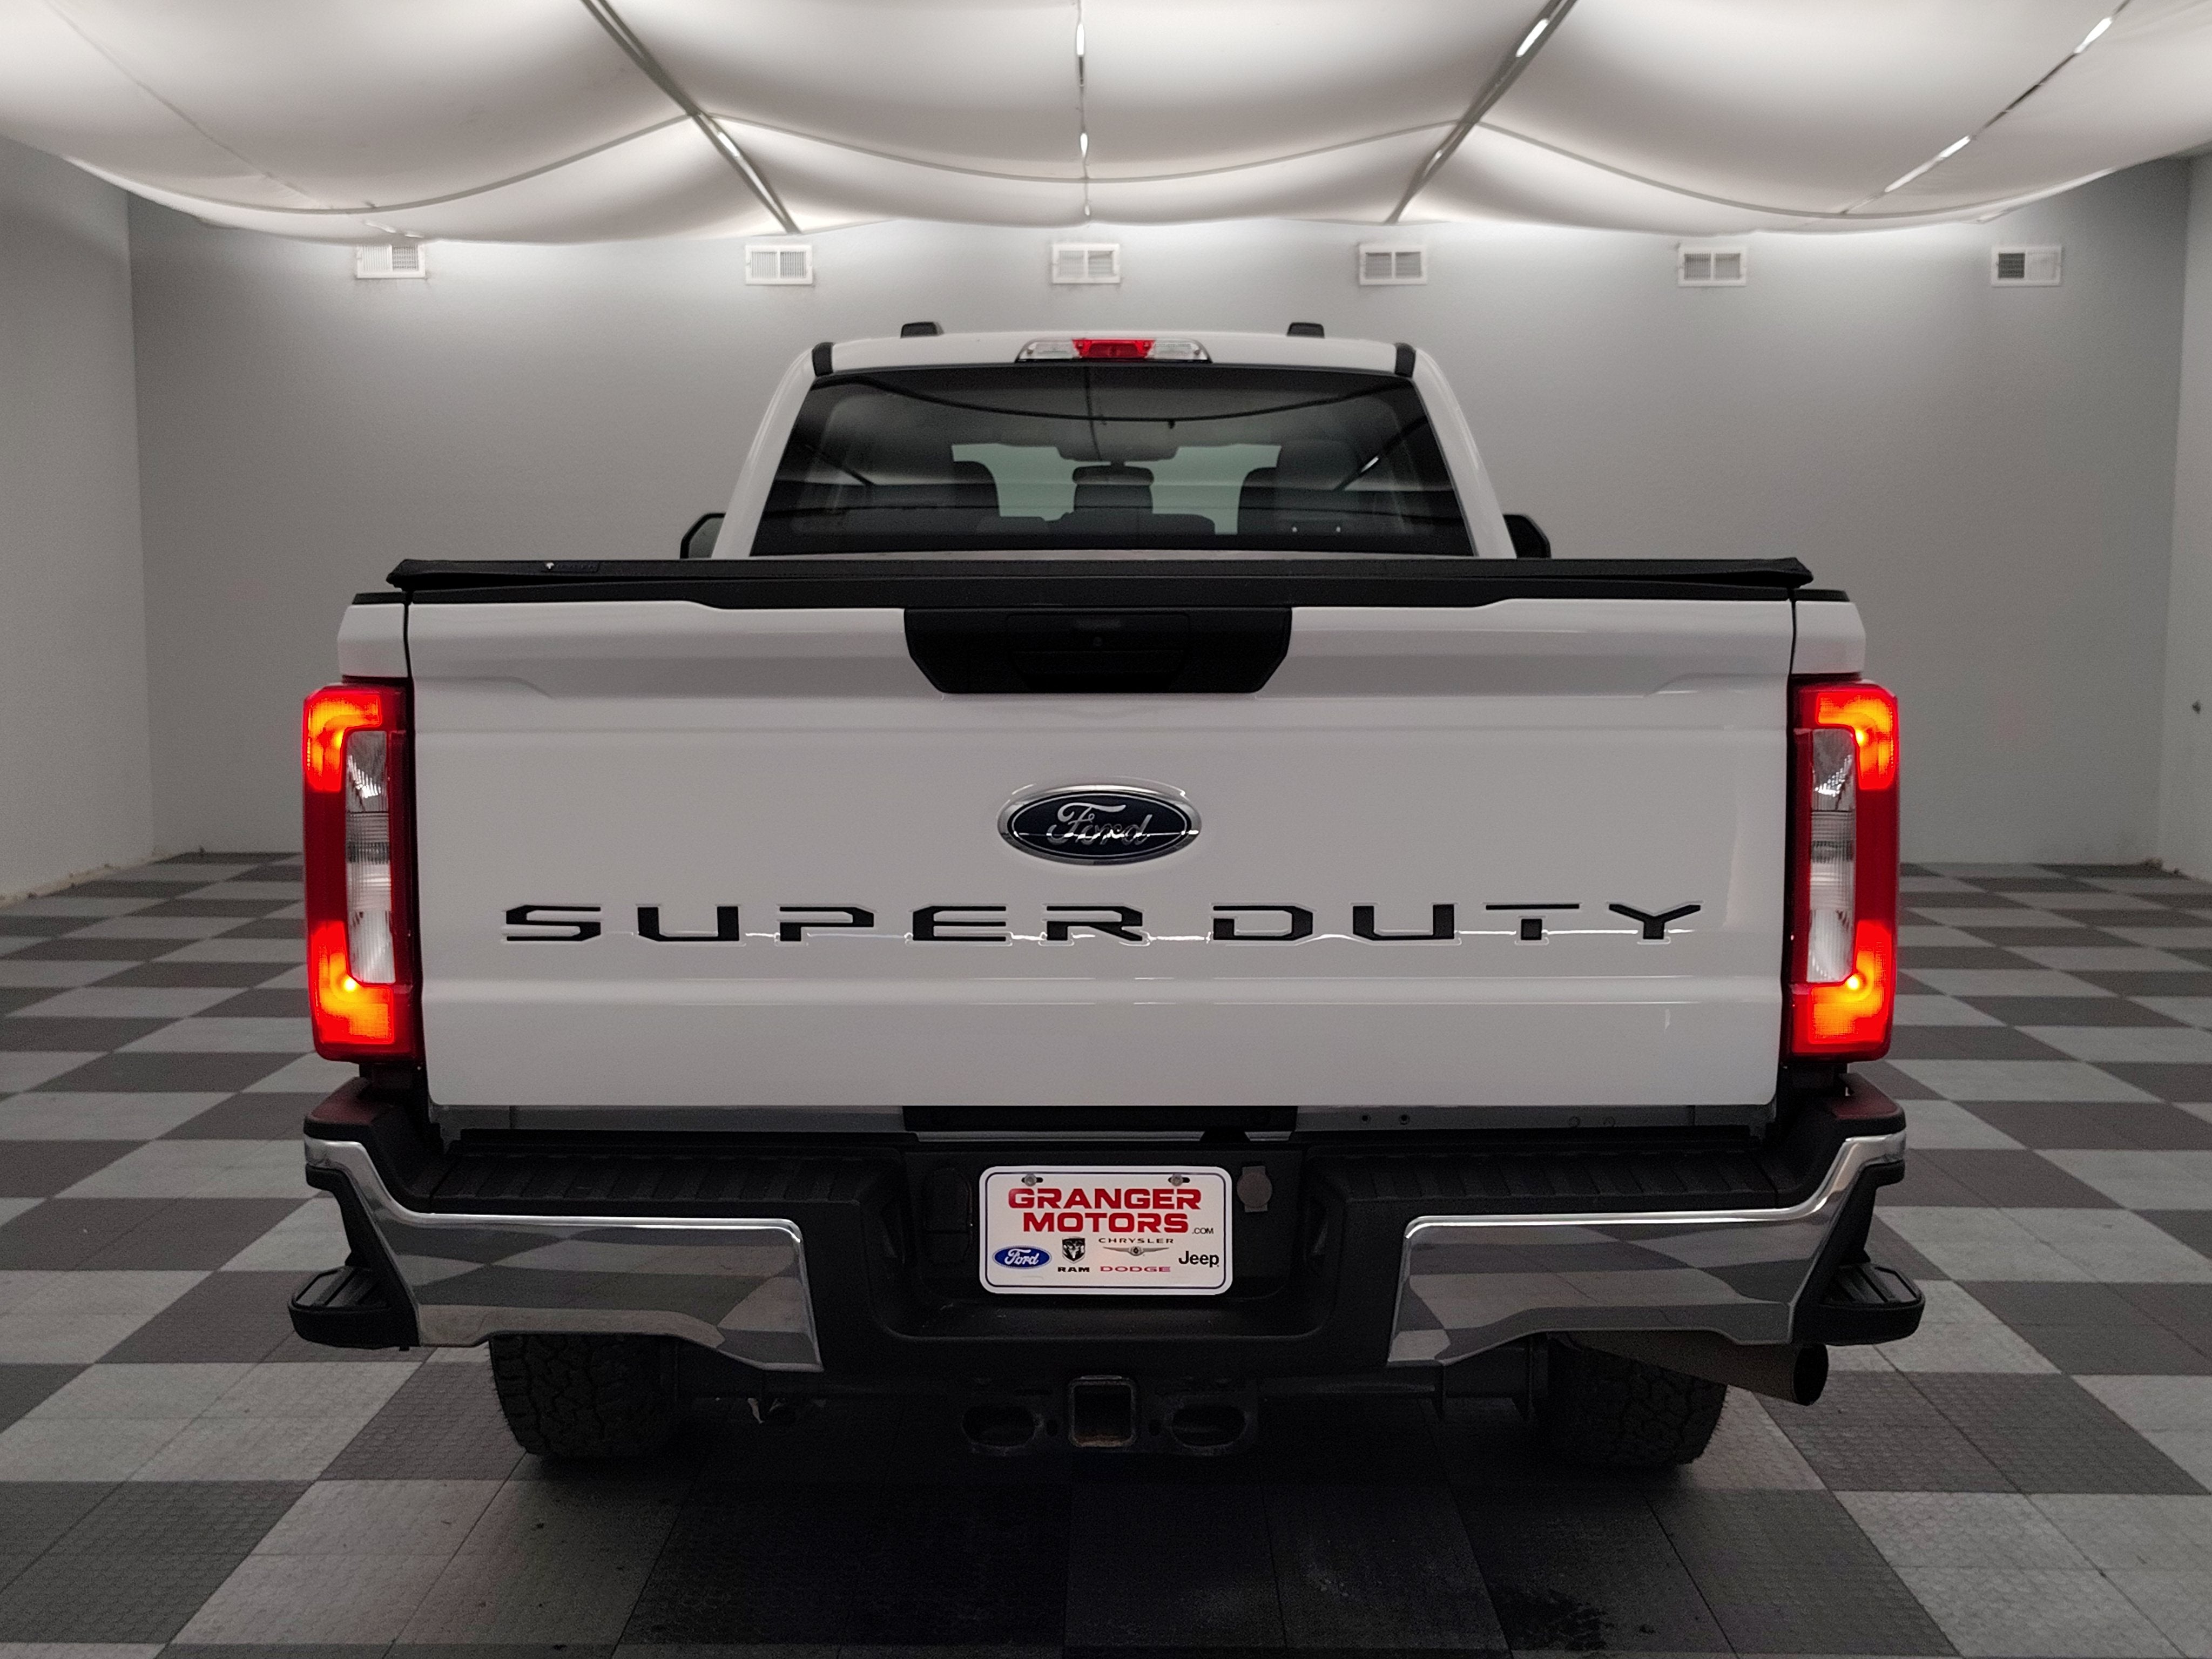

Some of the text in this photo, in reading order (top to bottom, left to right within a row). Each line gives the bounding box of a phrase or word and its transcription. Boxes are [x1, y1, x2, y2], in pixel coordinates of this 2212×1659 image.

[1047, 802, 1152, 845] Ford
[505, 904, 1701, 942] SUPER DUTY
[1008, 1188, 1202, 1210] GRANGER
[1023, 1212, 1189, 1233] MOTORS
[1004, 1249, 1040, 1265] Ford
[1178, 1251, 1219, 1267] Jeep
